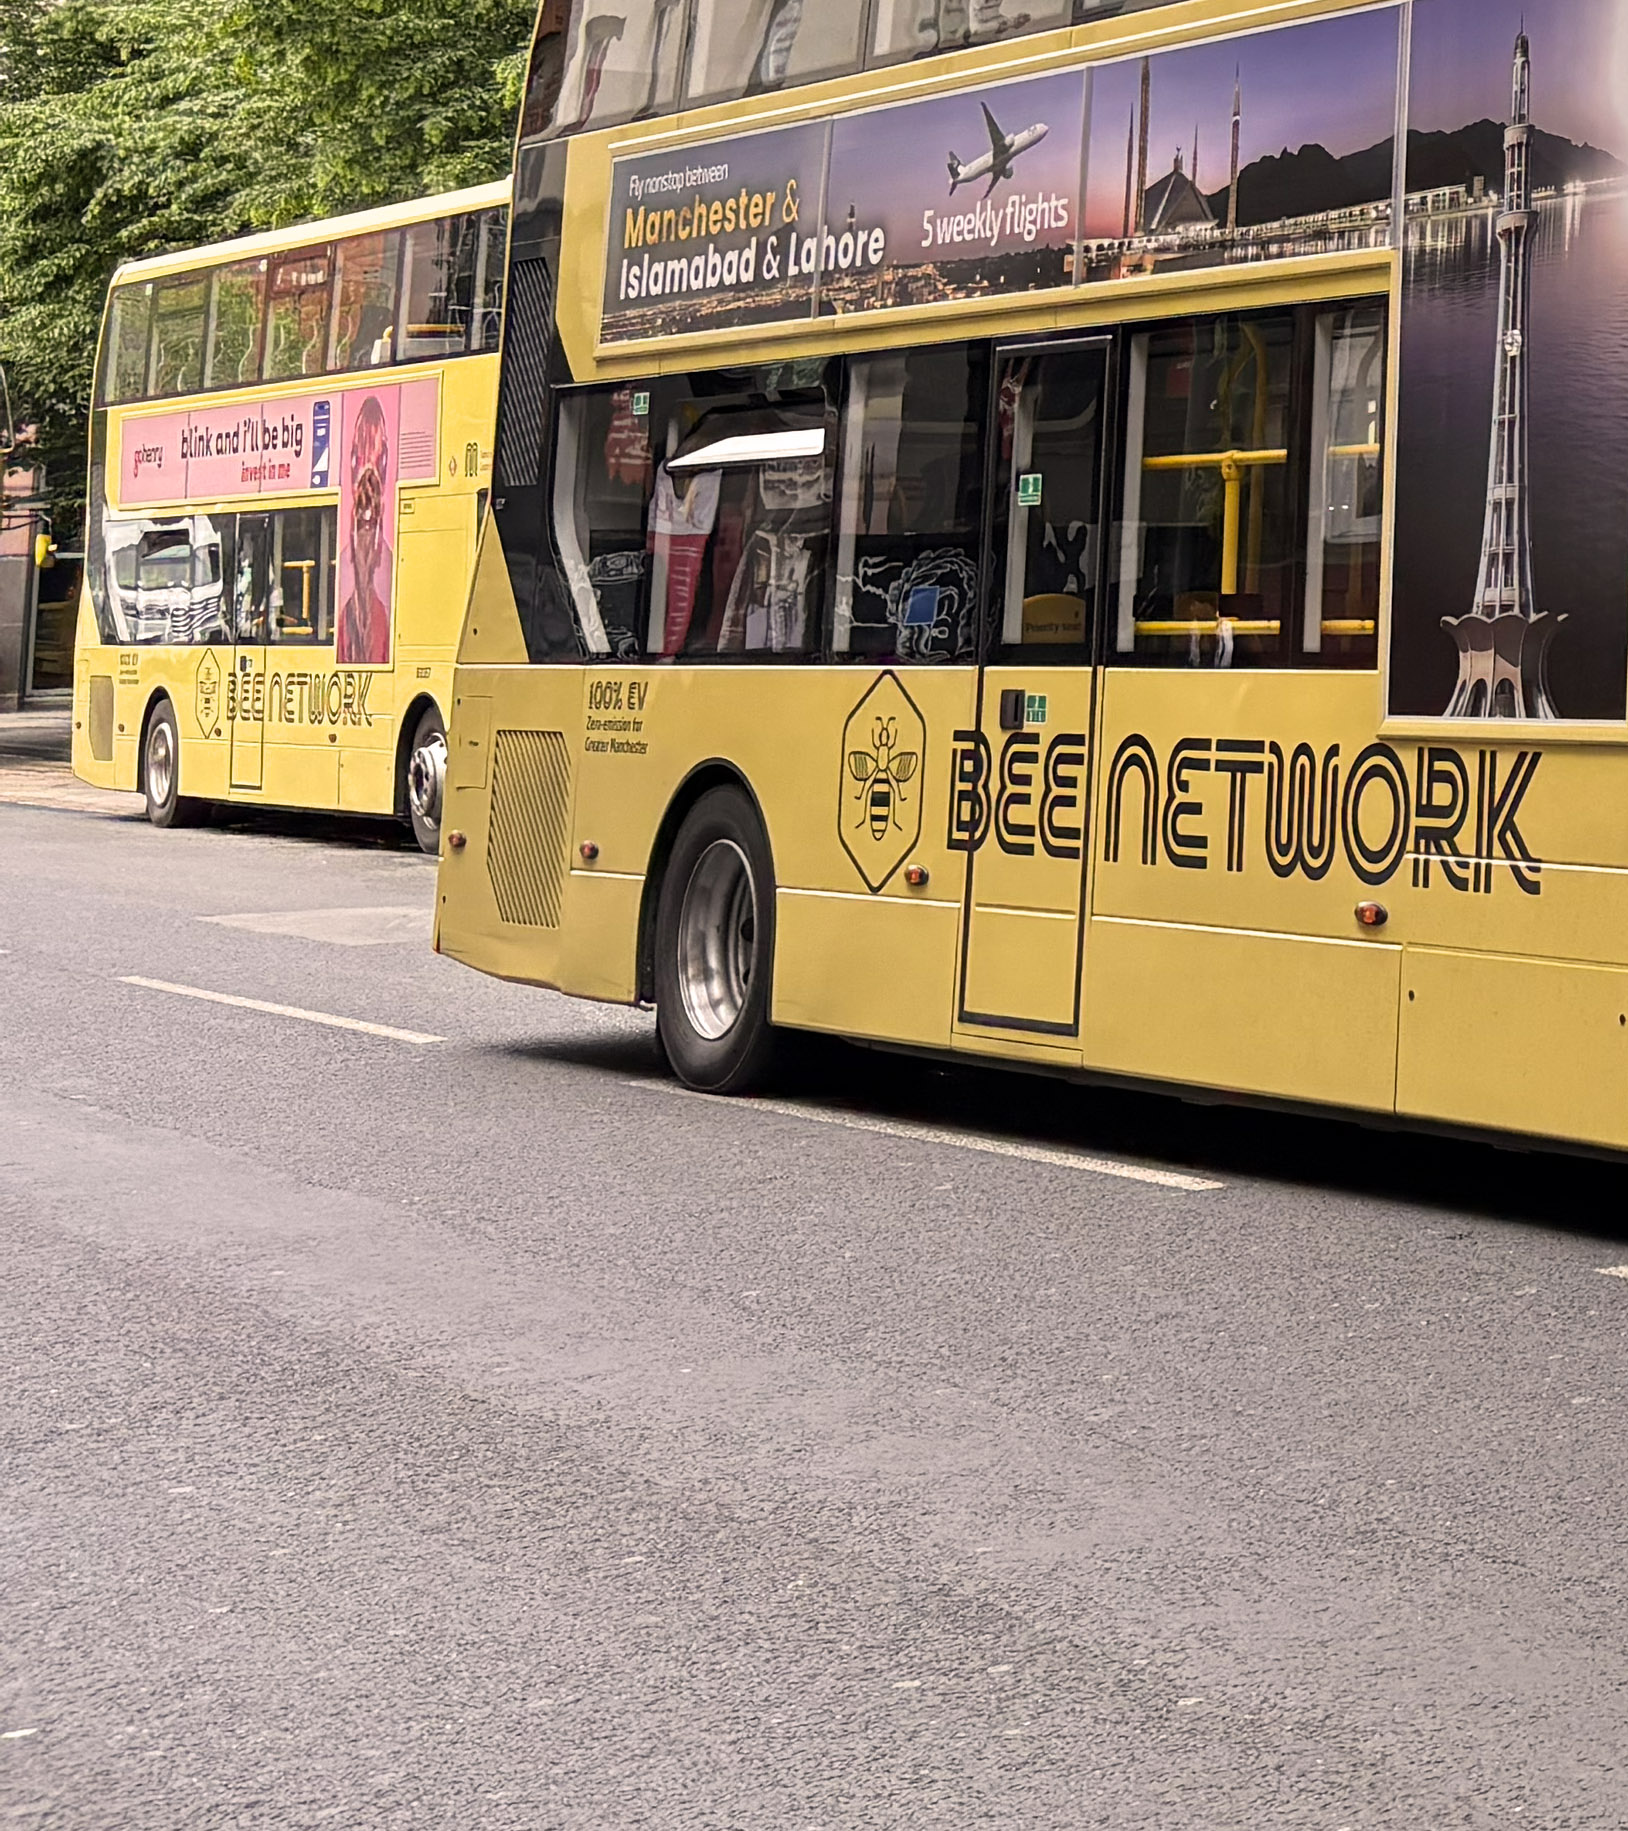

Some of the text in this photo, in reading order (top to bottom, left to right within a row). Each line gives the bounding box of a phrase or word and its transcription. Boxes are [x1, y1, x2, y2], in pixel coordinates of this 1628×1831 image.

[629, 164, 728, 201] Fly nonstop between
[624, 179, 799, 249] Manchester &
[921, 192, 1069, 247] 5 weekly flights
[620, 225, 885, 300] Islamabad & Lahore
[181, 414, 303, 460] blink and i'll be big
[241, 458, 290, 482] invest in me
[227, 671, 373, 728] BEE NETWORK
[588, 679, 649, 711] 100% EV
[946, 729, 1541, 896] BEE NETWORK
